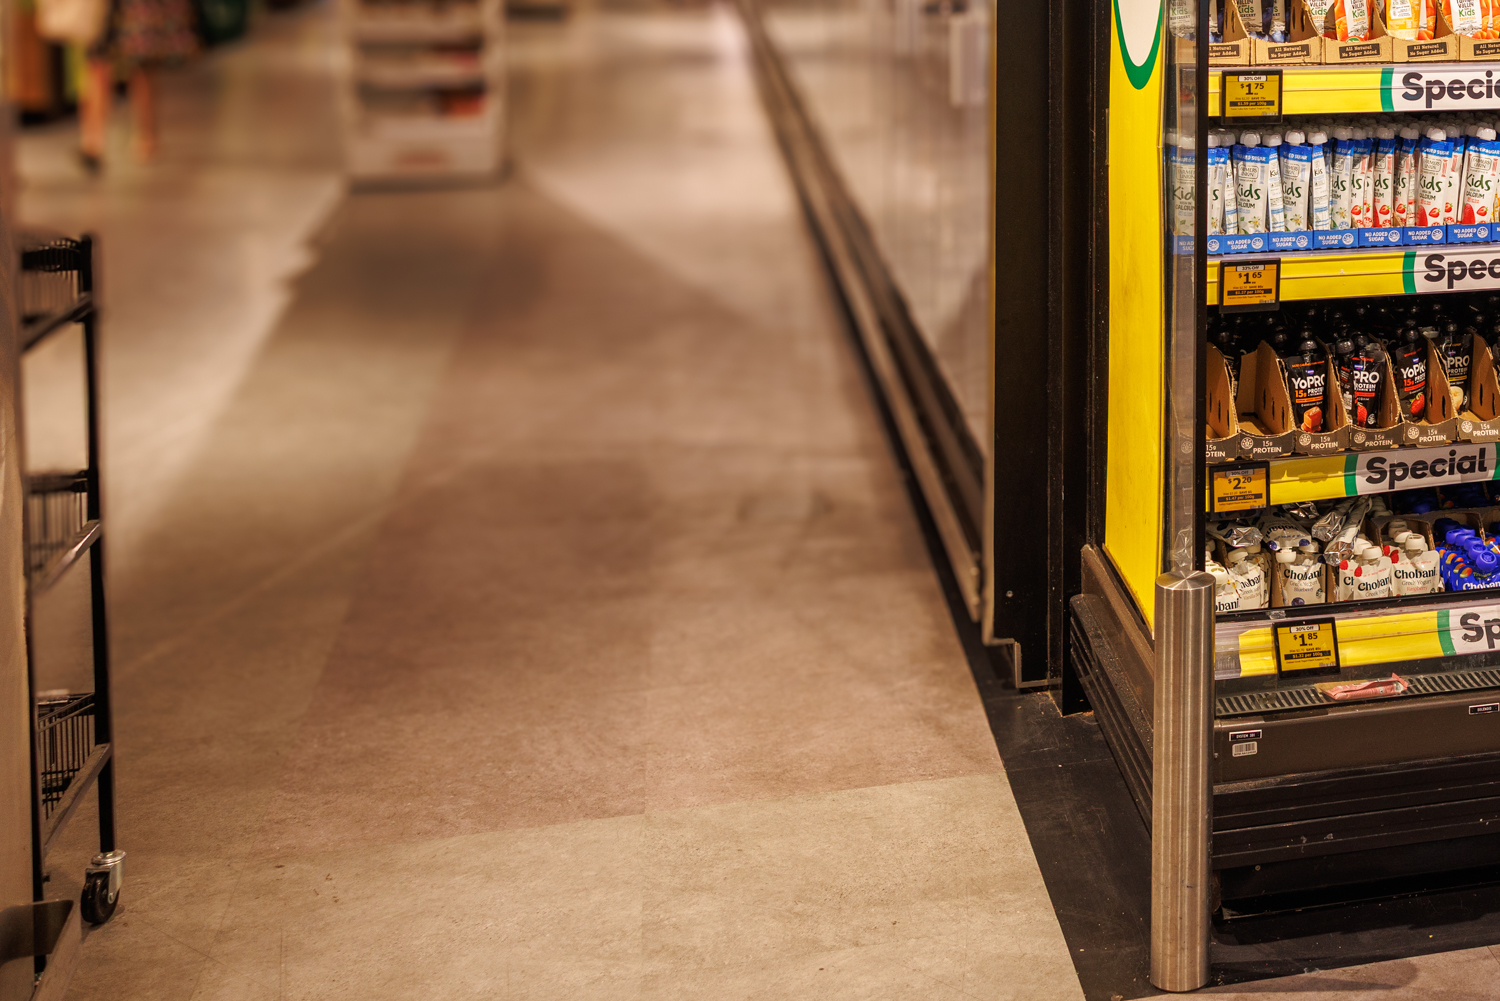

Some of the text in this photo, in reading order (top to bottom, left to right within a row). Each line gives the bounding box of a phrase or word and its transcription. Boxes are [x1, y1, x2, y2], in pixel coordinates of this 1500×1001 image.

[1352, 10, 1365, 18] Kids
[1459, 9, 1475, 17] Kids
[1419, 434, 1446, 442] PROTEIN
[1365, 439, 1392, 447] PROTEIN
[1365, 447, 1488, 490] Special
[1283, 567, 1323, 581] Chobani
[1394, 568, 1437, 580] Chobani
